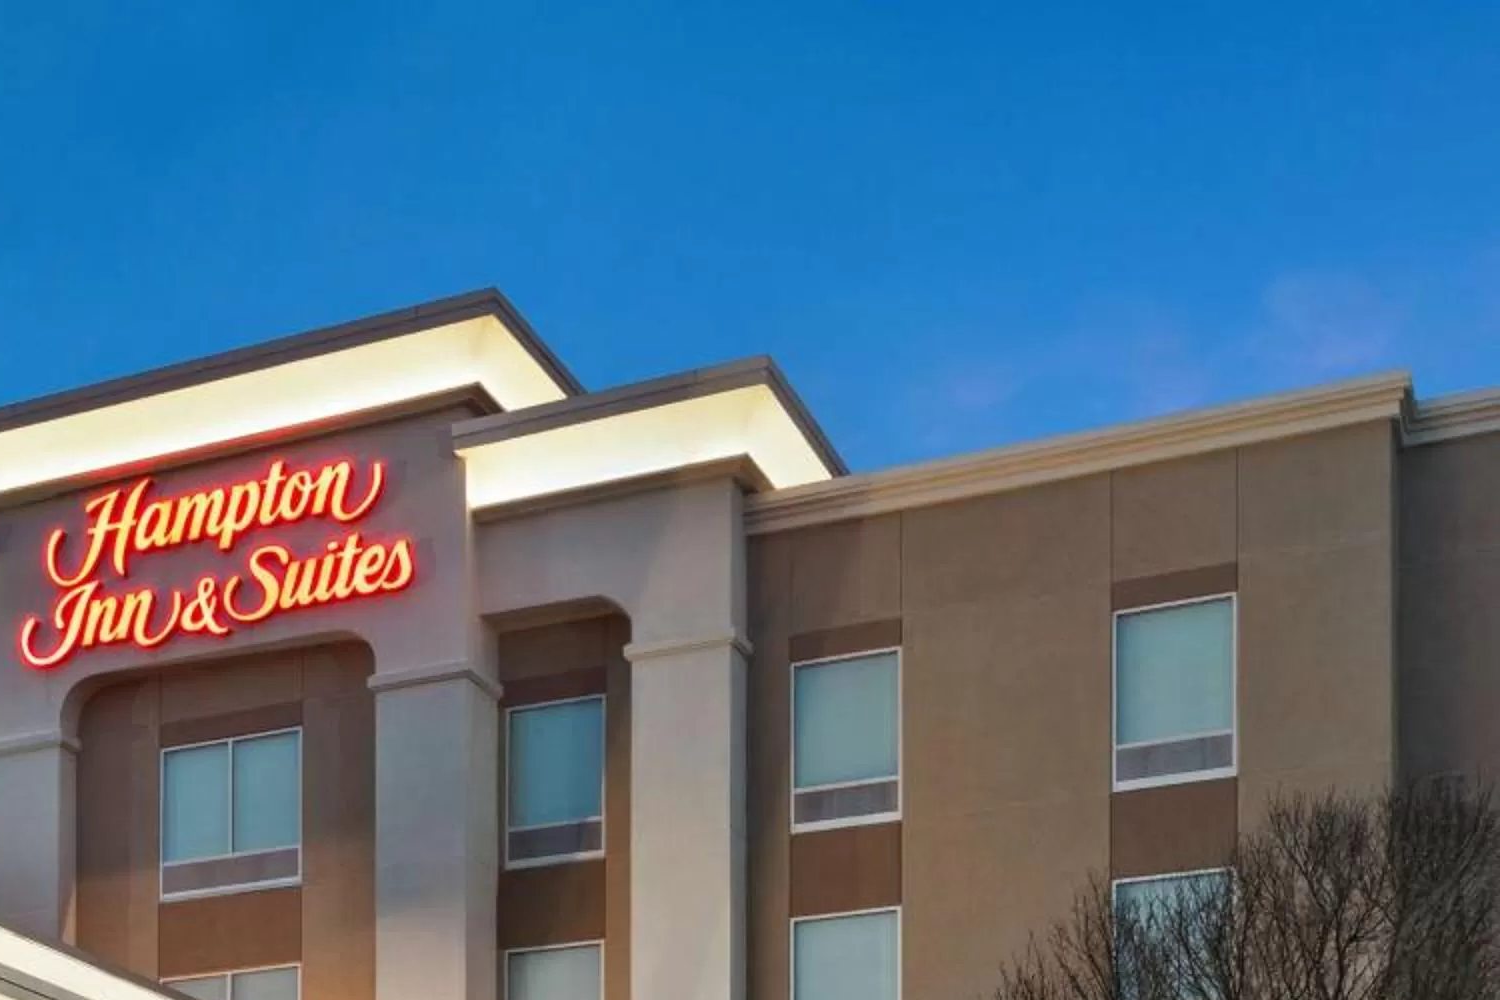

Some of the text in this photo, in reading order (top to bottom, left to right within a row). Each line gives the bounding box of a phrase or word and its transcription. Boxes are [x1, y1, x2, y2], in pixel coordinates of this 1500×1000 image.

[46, 459, 384, 587] Hampton
[20, 531, 414, 667] Inn & Suites
